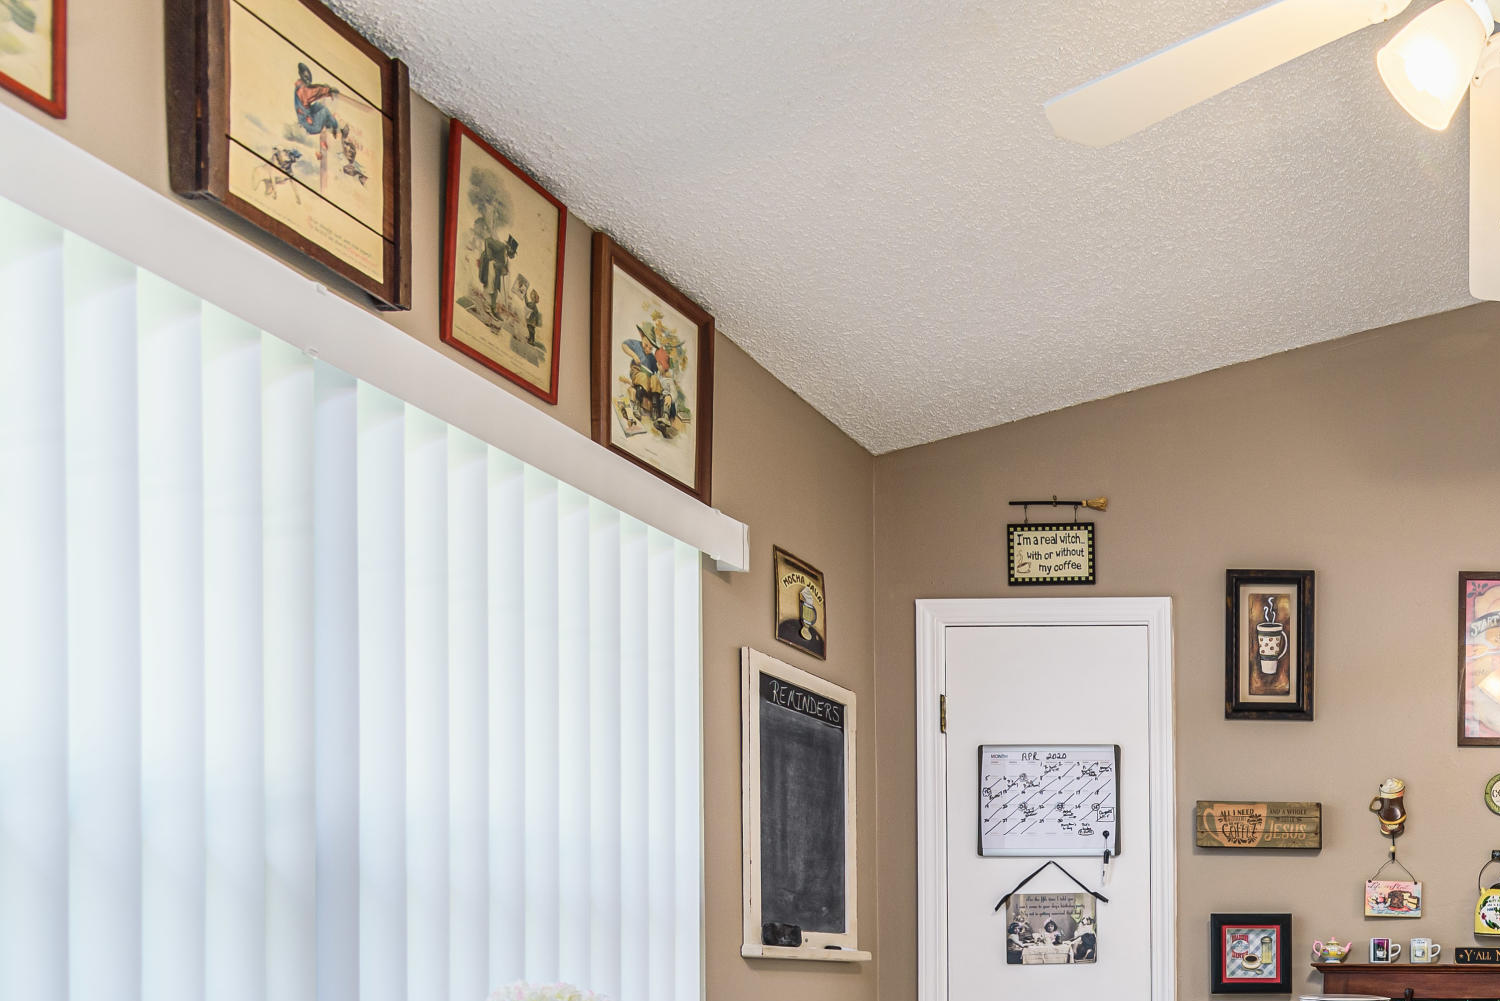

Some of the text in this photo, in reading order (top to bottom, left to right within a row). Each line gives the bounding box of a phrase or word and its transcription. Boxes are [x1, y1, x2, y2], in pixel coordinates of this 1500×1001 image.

[1016, 533, 1031, 545] I'm
[1033, 536, 1039, 545] a
[1040, 533, 1057, 545] real
[1027, 547, 1085, 560] with or without
[1038, 560, 1082, 575] my coffee
[782, 574, 823, 603] MOCHA JAVA
[1470, 617, 1498, 637] START
[769, 680, 841, 722] REMINDERS
[1046, 752, 1067, 760] 2020
[1264, 820, 1306, 842] JESUS
[1464, 949, 1492, 961] Y'ALL
